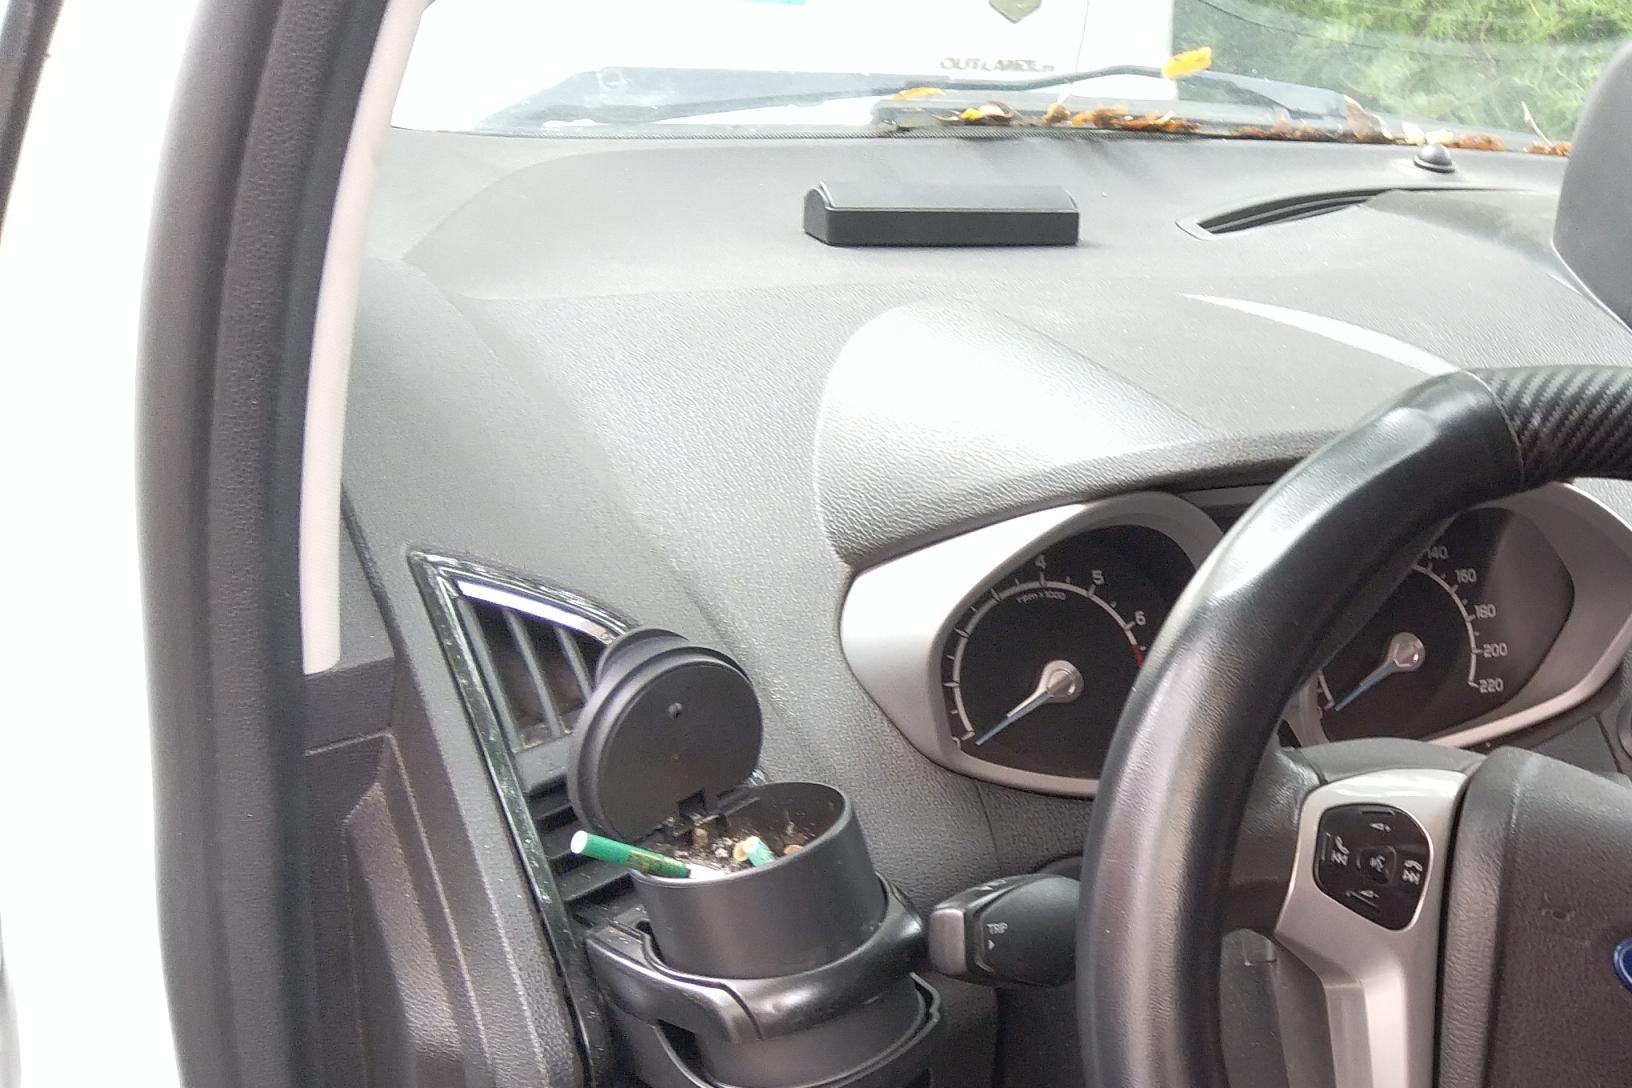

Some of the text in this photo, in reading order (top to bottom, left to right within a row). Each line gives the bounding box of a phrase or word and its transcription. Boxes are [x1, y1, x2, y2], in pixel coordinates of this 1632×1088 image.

[1091, 569, 1105, 585] 5
[1455, 568, 1478, 583] 160
[1133, 610, 1147, 626] 6
[1473, 603, 1497, 619] 180
[1482, 642, 1508, 658] 200
[1478, 677, 1504, 694] 220
